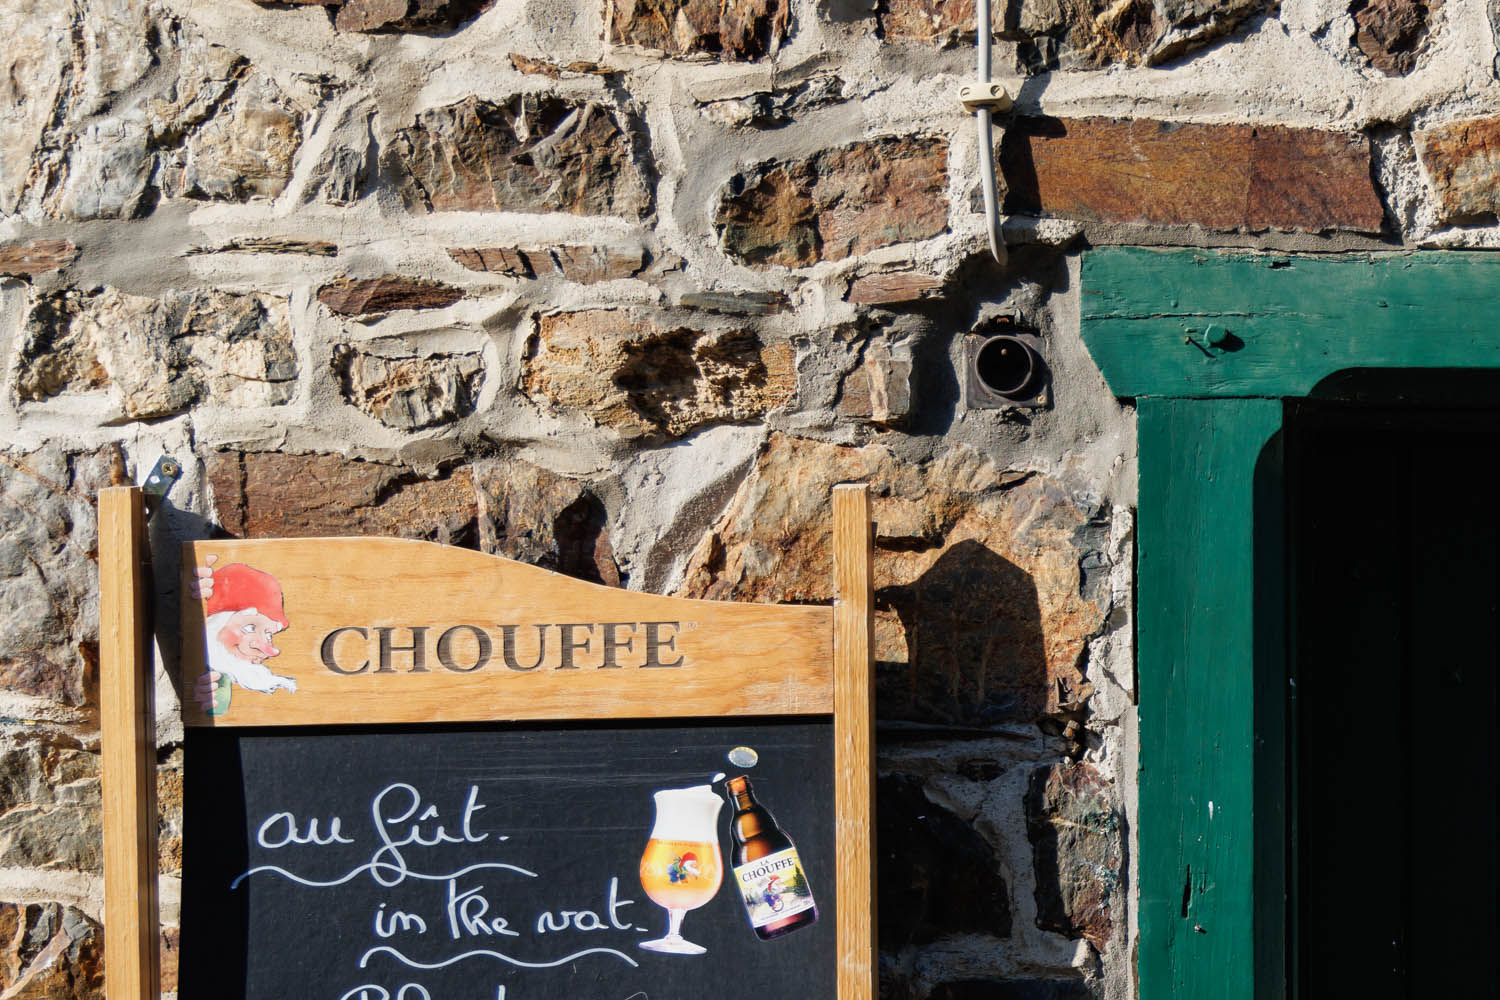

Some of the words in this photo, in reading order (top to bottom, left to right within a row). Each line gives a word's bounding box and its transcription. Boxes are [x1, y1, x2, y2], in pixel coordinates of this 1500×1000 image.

[320, 621, 685, 676] CHOUFFE
[257, 812, 355, 849] au
[370, 782, 511, 887] fût.
[742, 857, 795, 882] CHOUFFE
[375, 902, 427, 938] in
[447, 877, 520, 940] the
